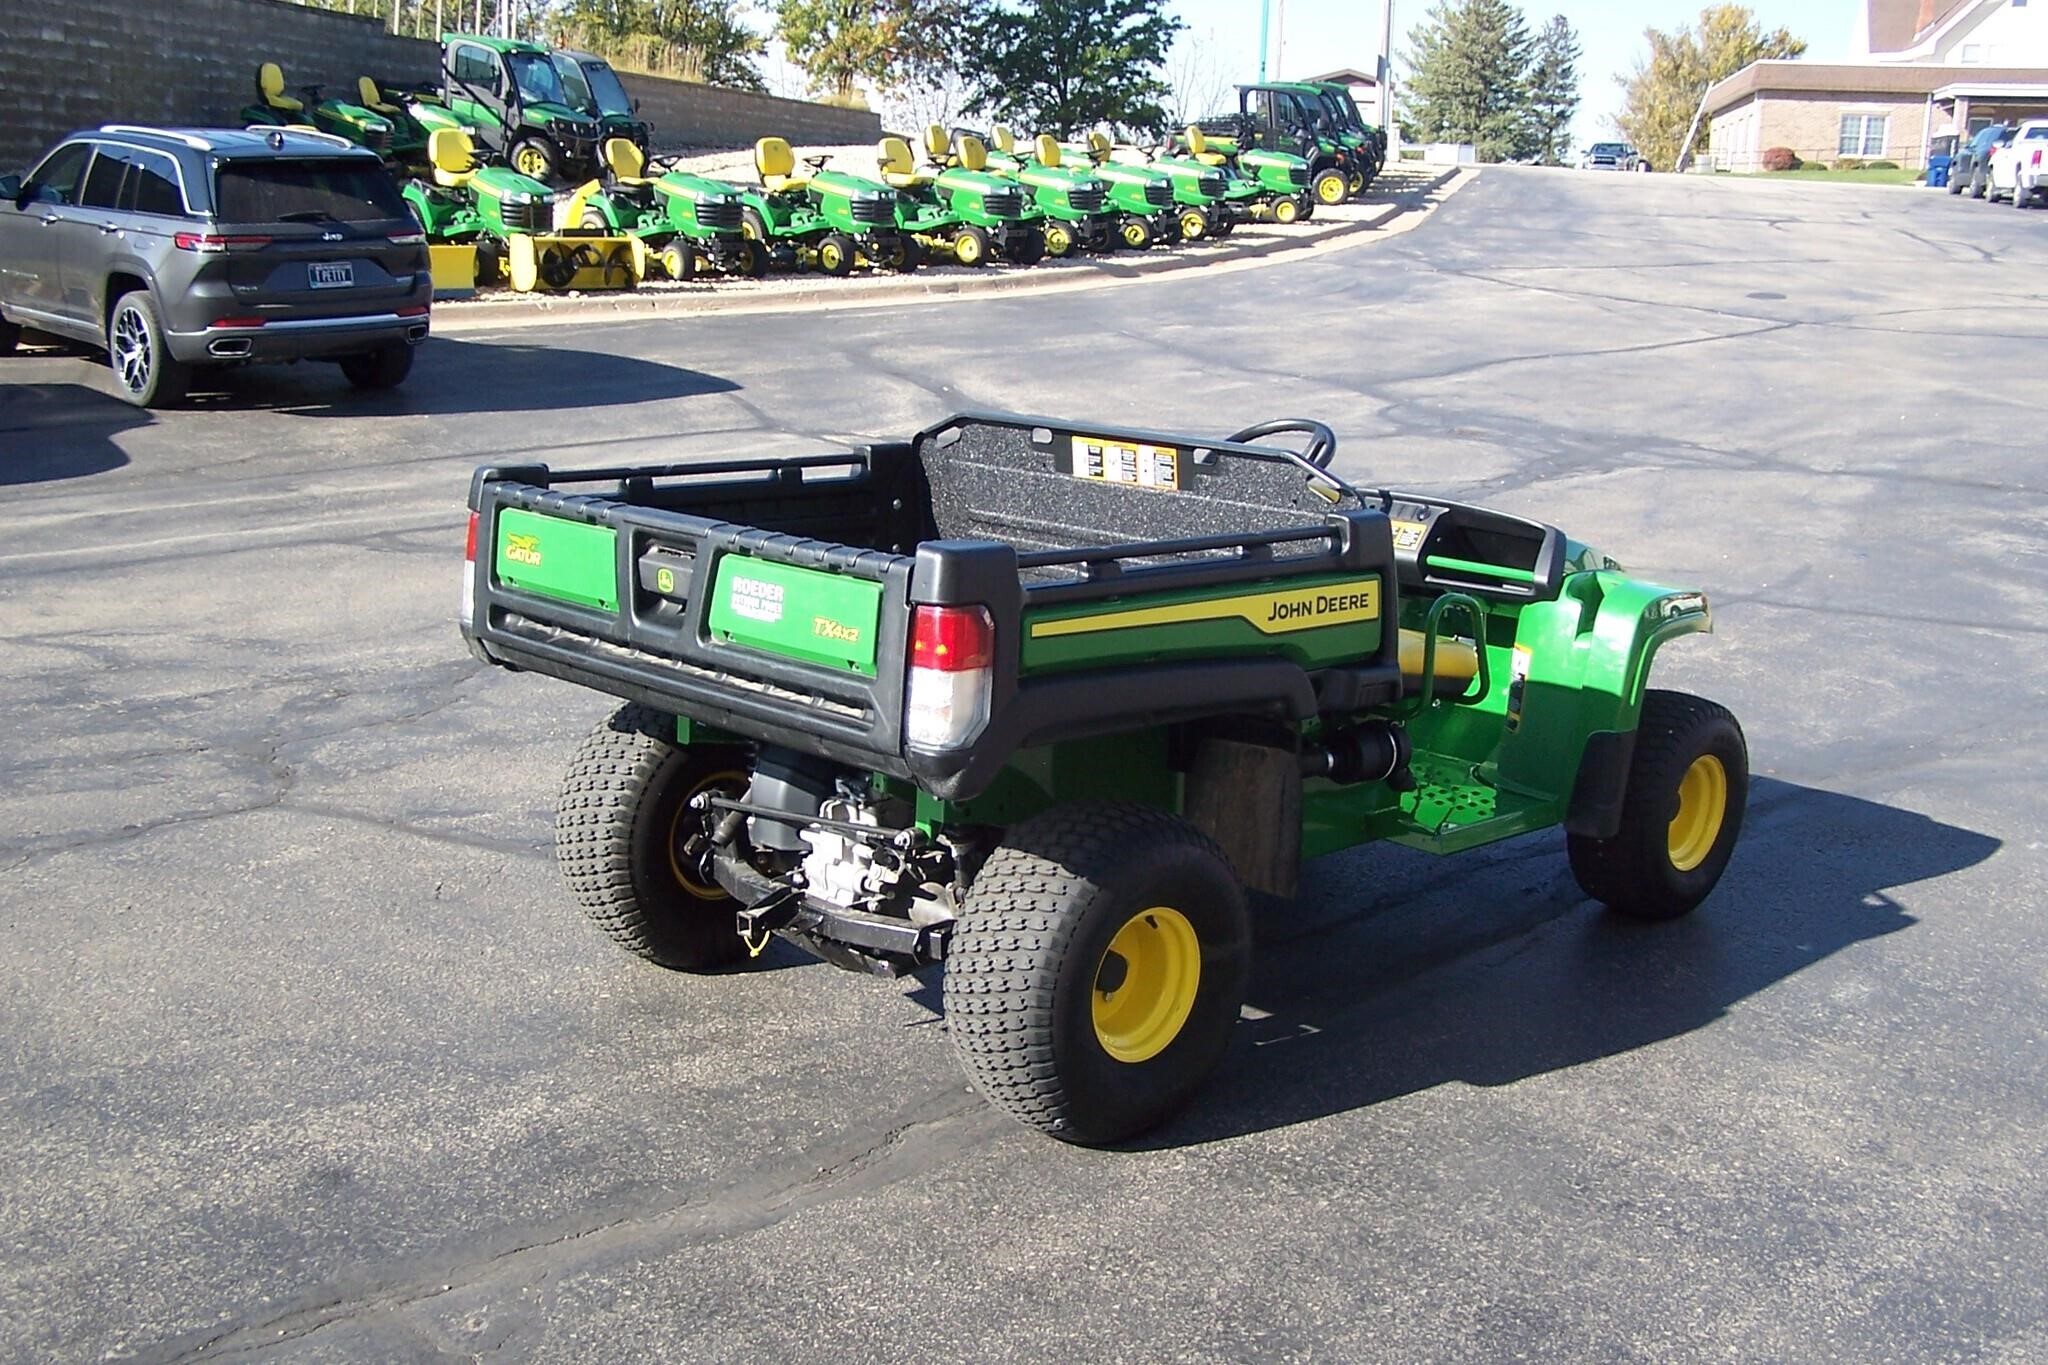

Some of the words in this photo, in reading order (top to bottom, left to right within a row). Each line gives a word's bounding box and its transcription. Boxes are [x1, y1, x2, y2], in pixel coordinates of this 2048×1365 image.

[506, 544, 541, 567] GATOR
[732, 576, 784, 602] ROEDER
[1267, 601, 1313, 621] JOHN
[1316, 593, 1369, 614] DEERE
